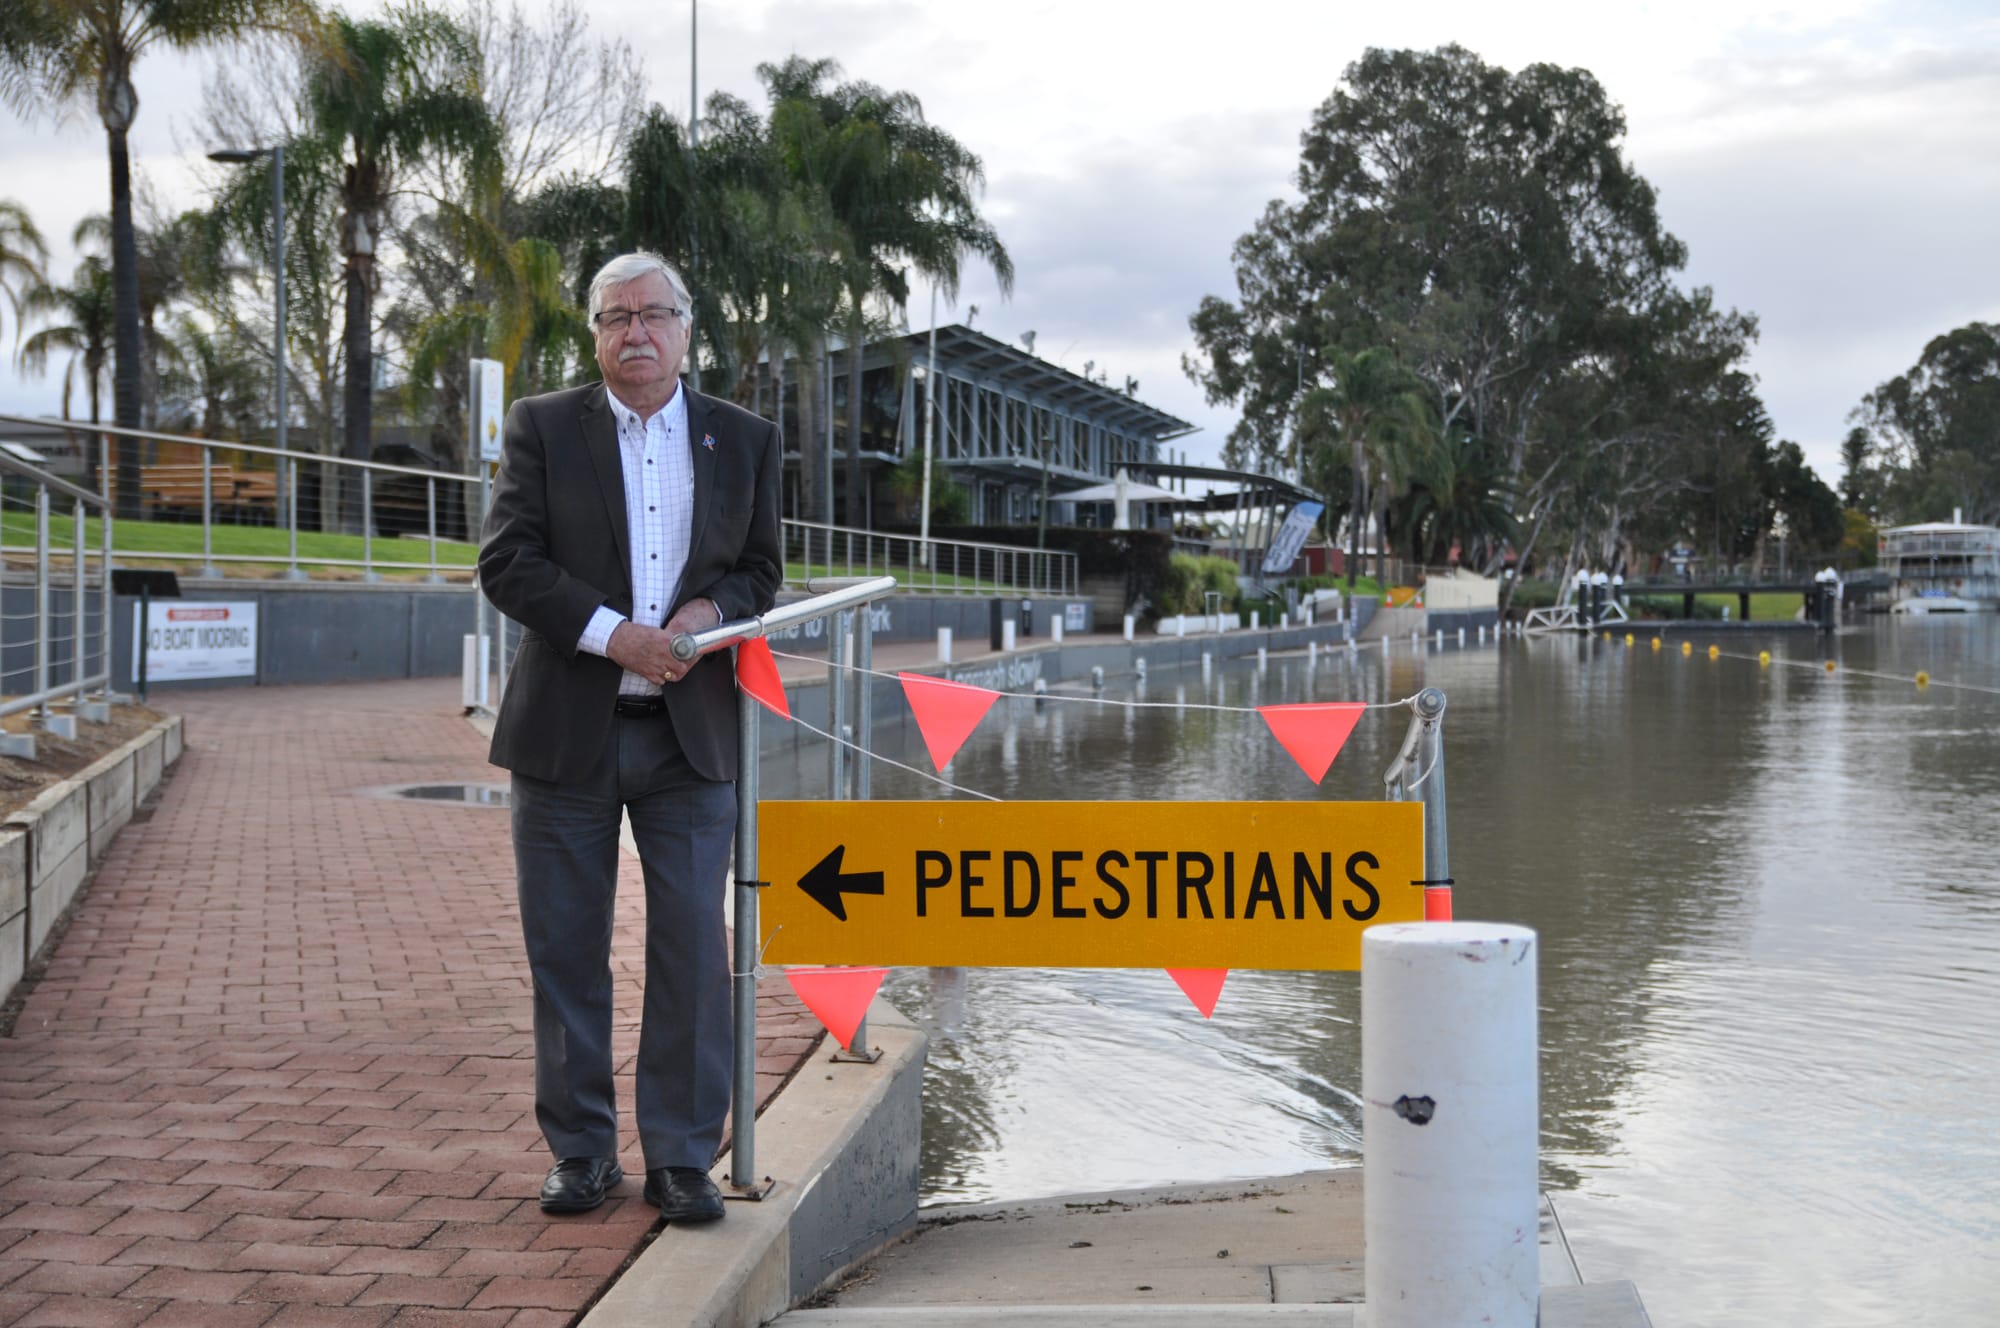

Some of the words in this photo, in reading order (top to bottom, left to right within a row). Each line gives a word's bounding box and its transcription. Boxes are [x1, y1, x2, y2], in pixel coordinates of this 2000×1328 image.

[163, 627, 196, 651] BOAT
[197, 626, 250, 650] MOORING
[915, 849, 1380, 921] PEDESTRIANS
